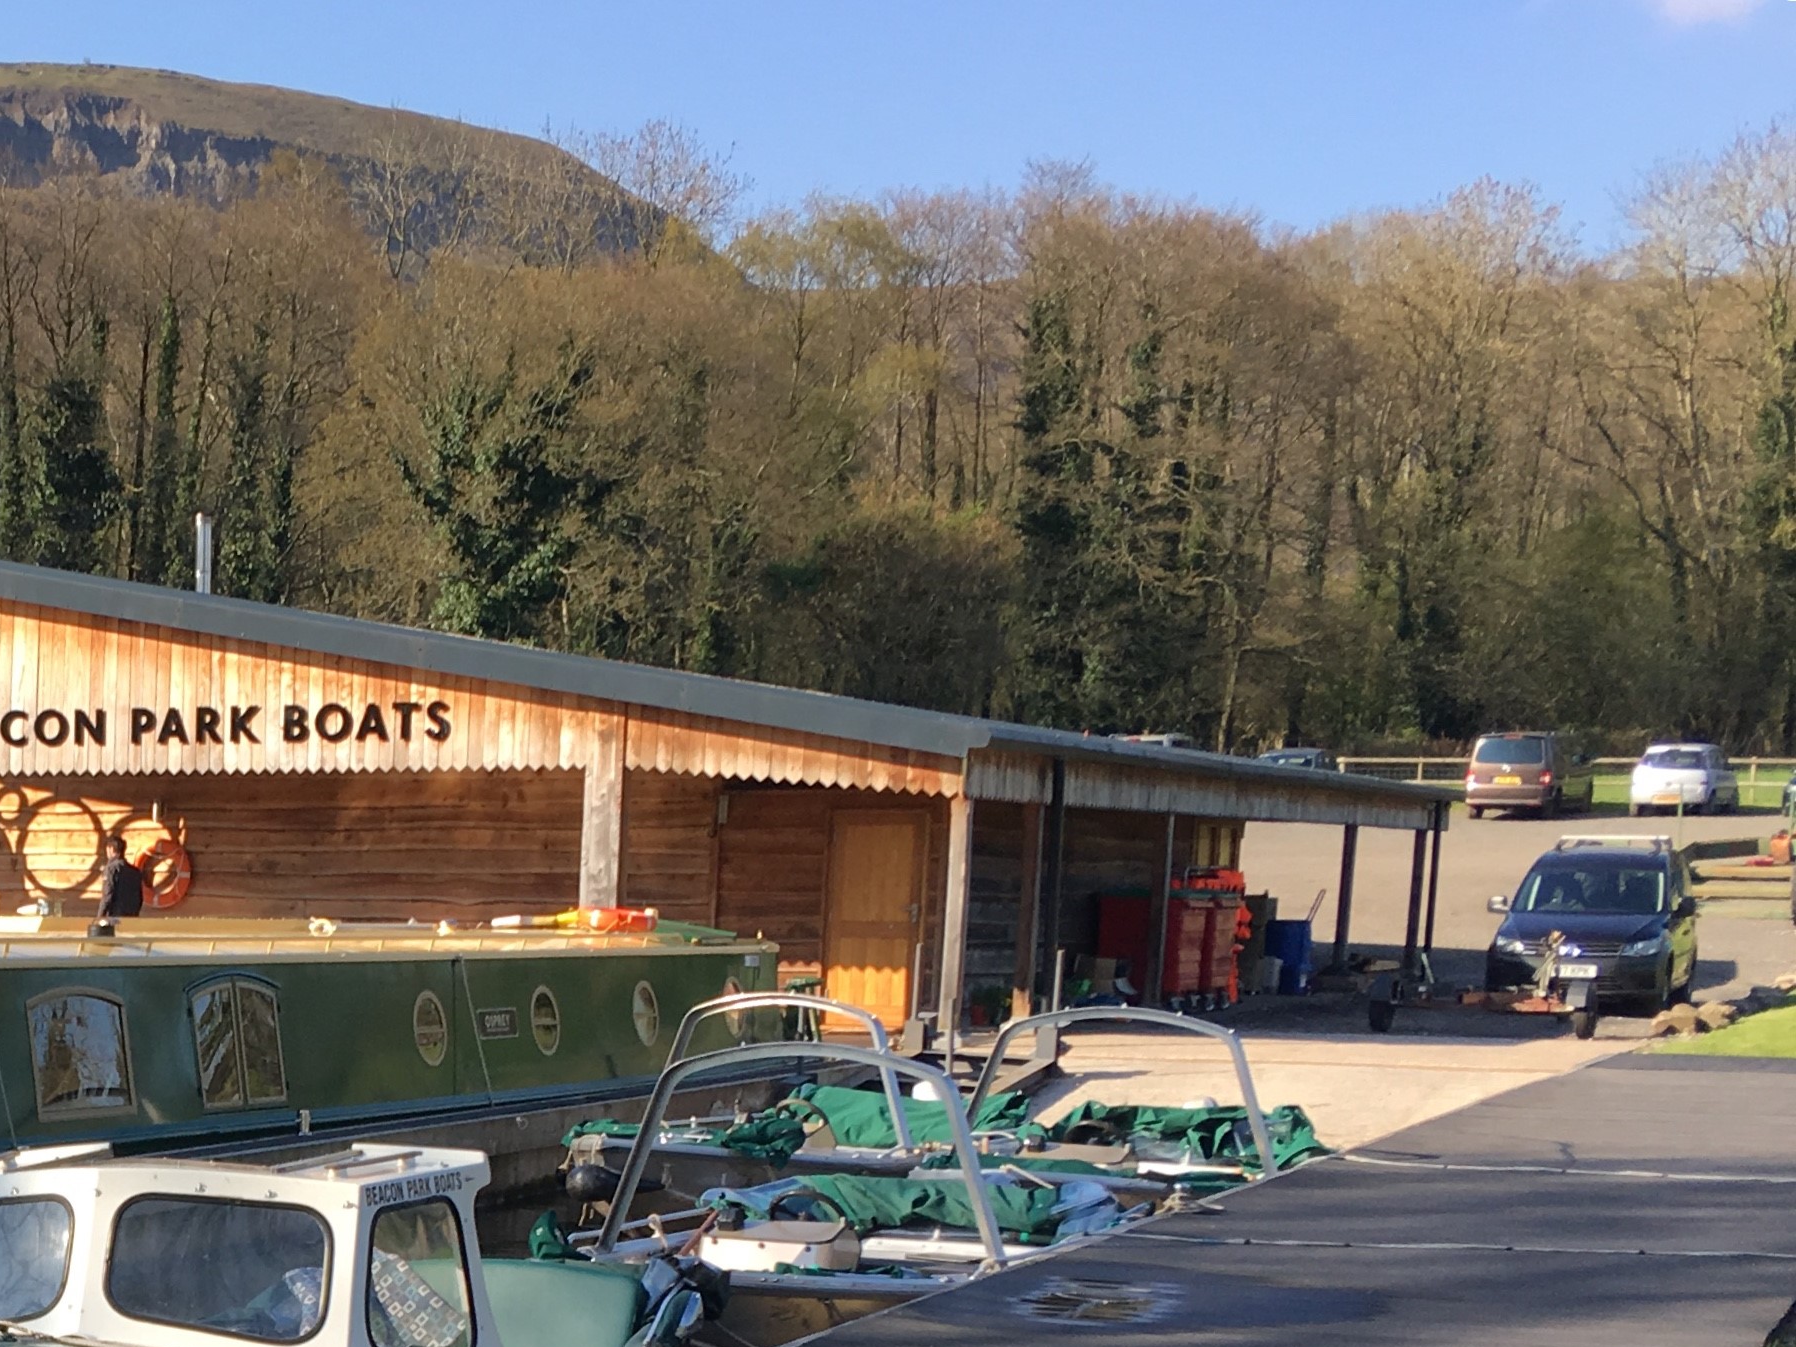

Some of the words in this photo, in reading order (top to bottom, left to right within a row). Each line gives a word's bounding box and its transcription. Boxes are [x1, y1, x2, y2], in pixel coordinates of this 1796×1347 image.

[130, 705, 262, 745] PARK
[282, 701, 452, 745] BOATS
[365, 1182, 404, 1207] BEACON
[406, 1178, 432, 1199] PARK
[433, 1171, 462, 1193] BOATS
